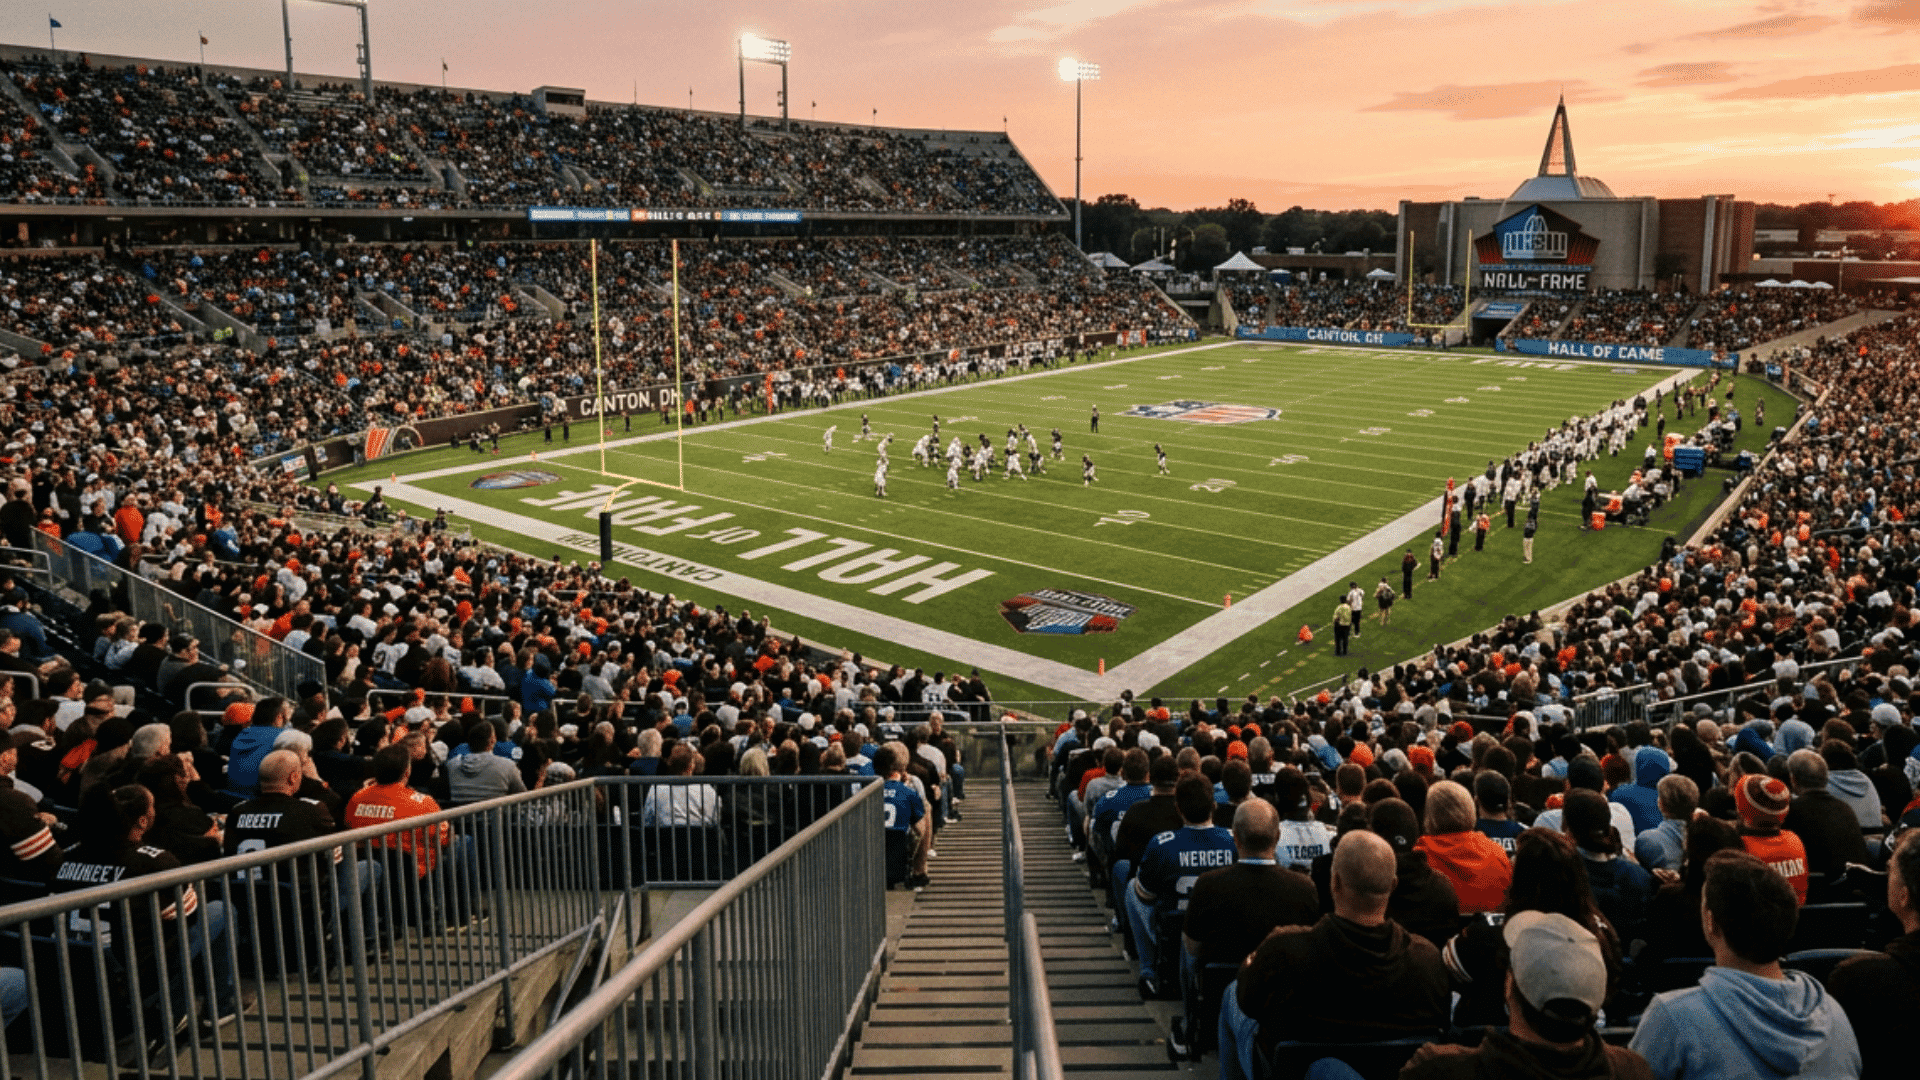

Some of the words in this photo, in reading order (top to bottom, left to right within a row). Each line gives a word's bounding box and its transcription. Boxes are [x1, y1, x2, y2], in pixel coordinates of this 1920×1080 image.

[1548, 341, 1587, 357] HALL
[1592, 345, 1614, 359] OF
[685, 526, 761, 545] OF
[736, 527, 997, 604] HALL
